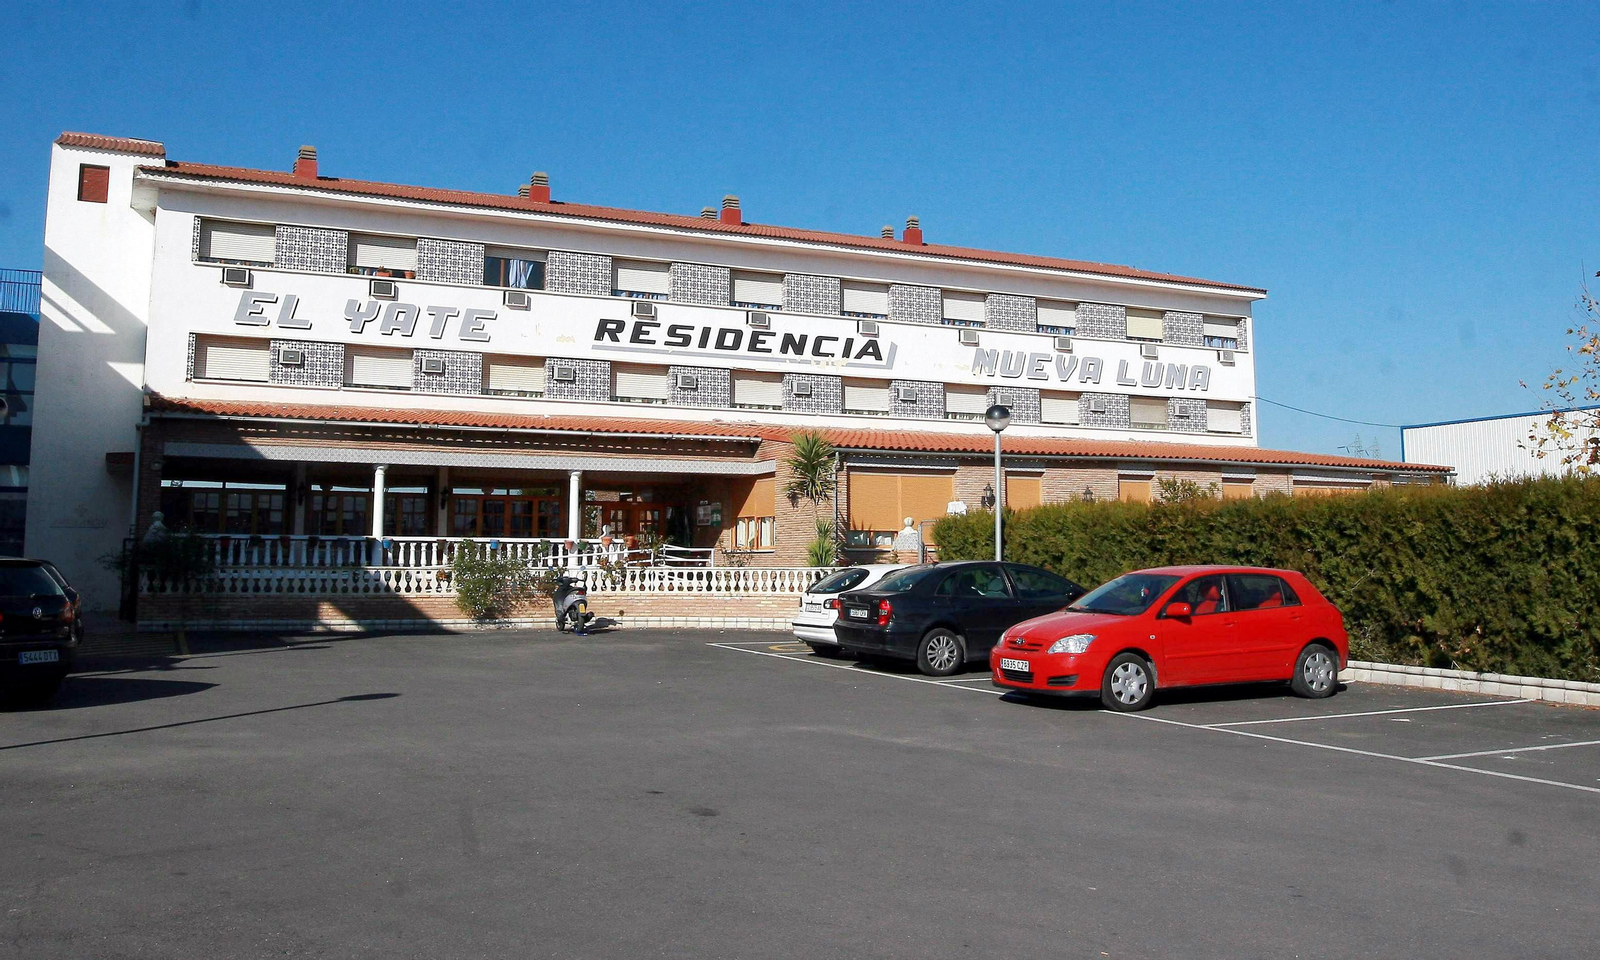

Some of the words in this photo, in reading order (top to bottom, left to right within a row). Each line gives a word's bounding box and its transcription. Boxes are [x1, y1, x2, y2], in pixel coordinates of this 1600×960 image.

[233, 290, 312, 330] EL
[344, 298, 498, 342] YATE
[594, 318, 883, 361] RESIDENCIA
[971, 347, 1103, 384] NUEVA
[1115, 359, 1211, 391] LUNA
